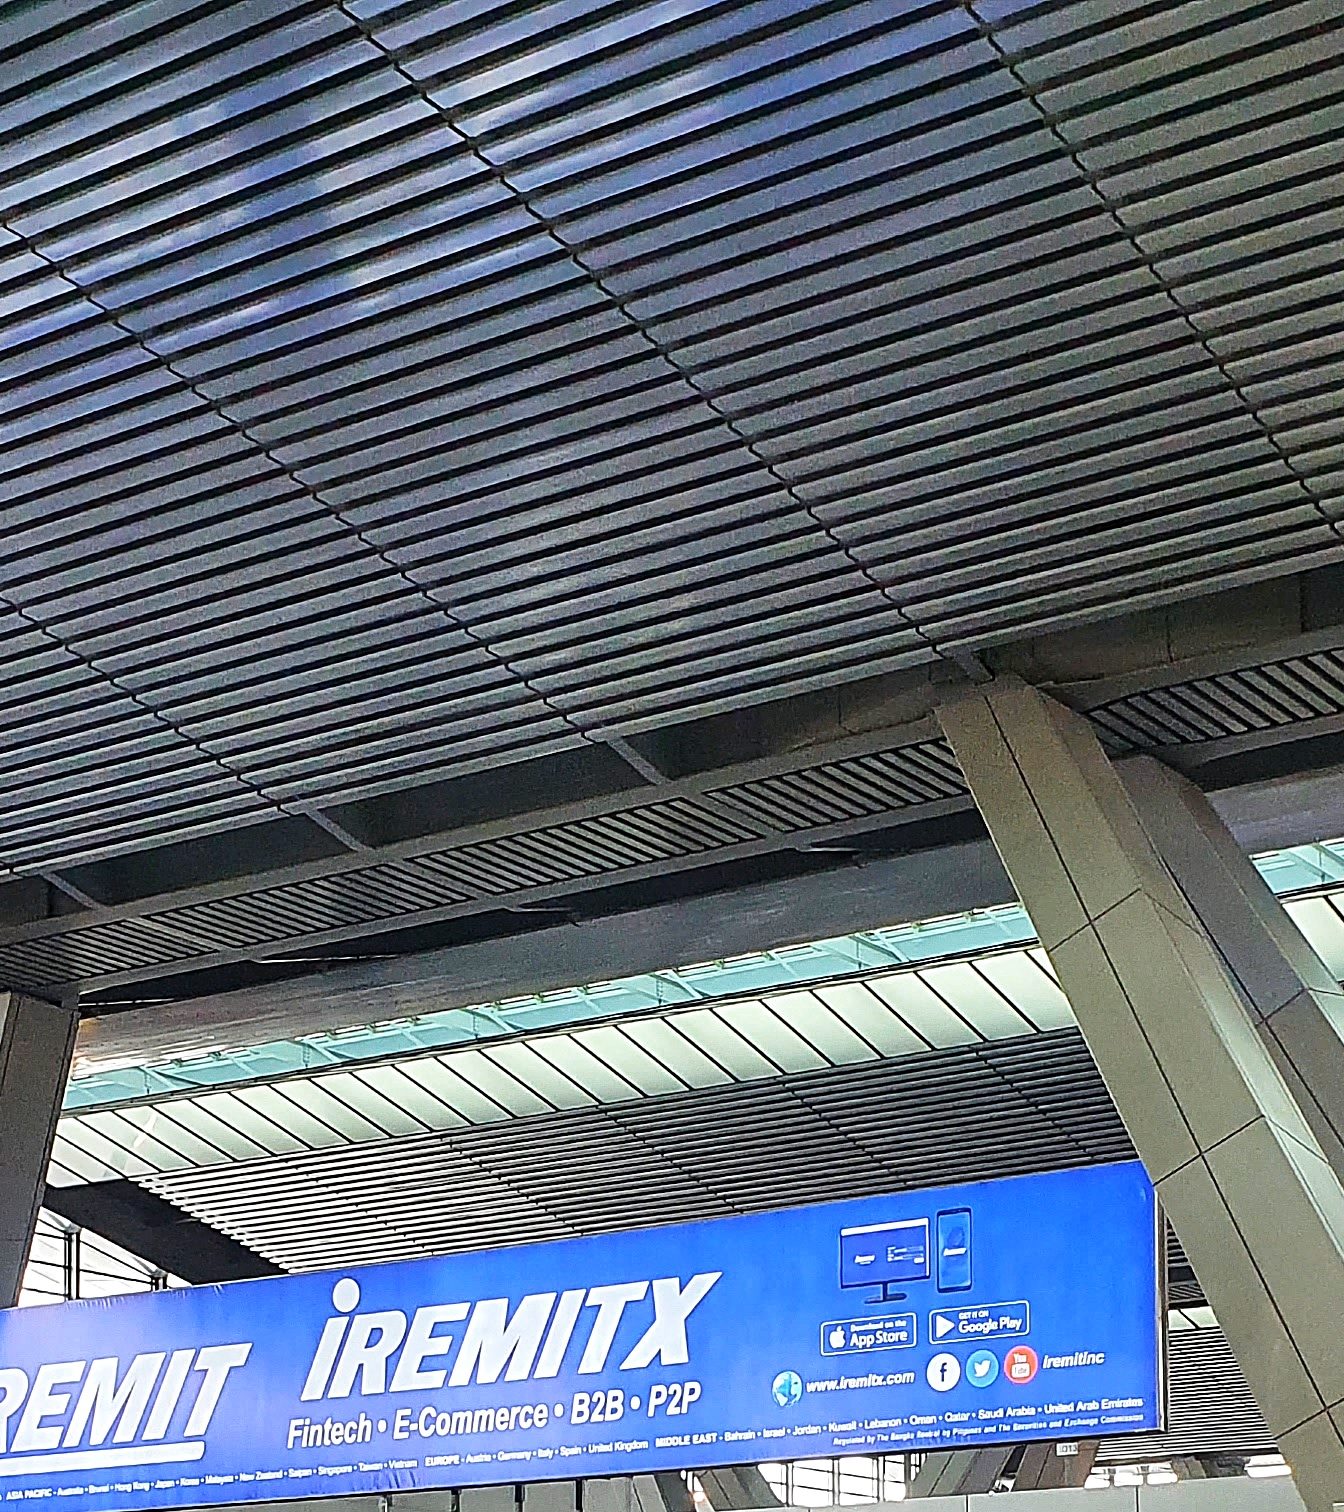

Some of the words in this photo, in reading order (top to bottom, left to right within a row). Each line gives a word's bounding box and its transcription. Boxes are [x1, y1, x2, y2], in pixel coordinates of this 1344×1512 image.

[958, 1318, 999, 1334] Google
[999, 1315, 1023, 1331] Play
[849, 1332, 875, 1349] App
[875, 1330, 908, 1344] Store
[1042, 1351, 1106, 1370] iremitinc
[805, 1371, 916, 1393] www.iremitx.com
[287, 1414, 373, 1450] Fintech
[393, 1404, 549, 1441] E-Commerce
[571, 1389, 625, 1426] B2B
[647, 1381, 702, 1418] P2P
[425, 1454, 460, 1467] EUROPE
[559, 1445, 582, 1457] Spain
[588, 1442, 613, 1454] United
[614, 1439, 649, 1453] Kingdom
[655, 1434, 691, 1448] MIDDLE
[692, 1432, 718, 1445] EAST
[724, 1429, 756, 1442] Bahrain
[762, 1426, 786, 1439] Israel
[792, 1423, 822, 1436] Jordan
[828, 1420, 857, 1433] Kuwait
[864, 1416, 902, 1430] Lebanon
[909, 1414, 937, 1426] Oman
[944, 1411, 971, 1423] Qatar
[977, 1408, 1004, 1420] Saudi
[1005, 1405, 1037, 1417] Arabia
[1044, 1402, 1075, 1414] United
[1076, 1399, 1100, 1412] Arab
[1101, 1397, 1144, 1411] Emirates
